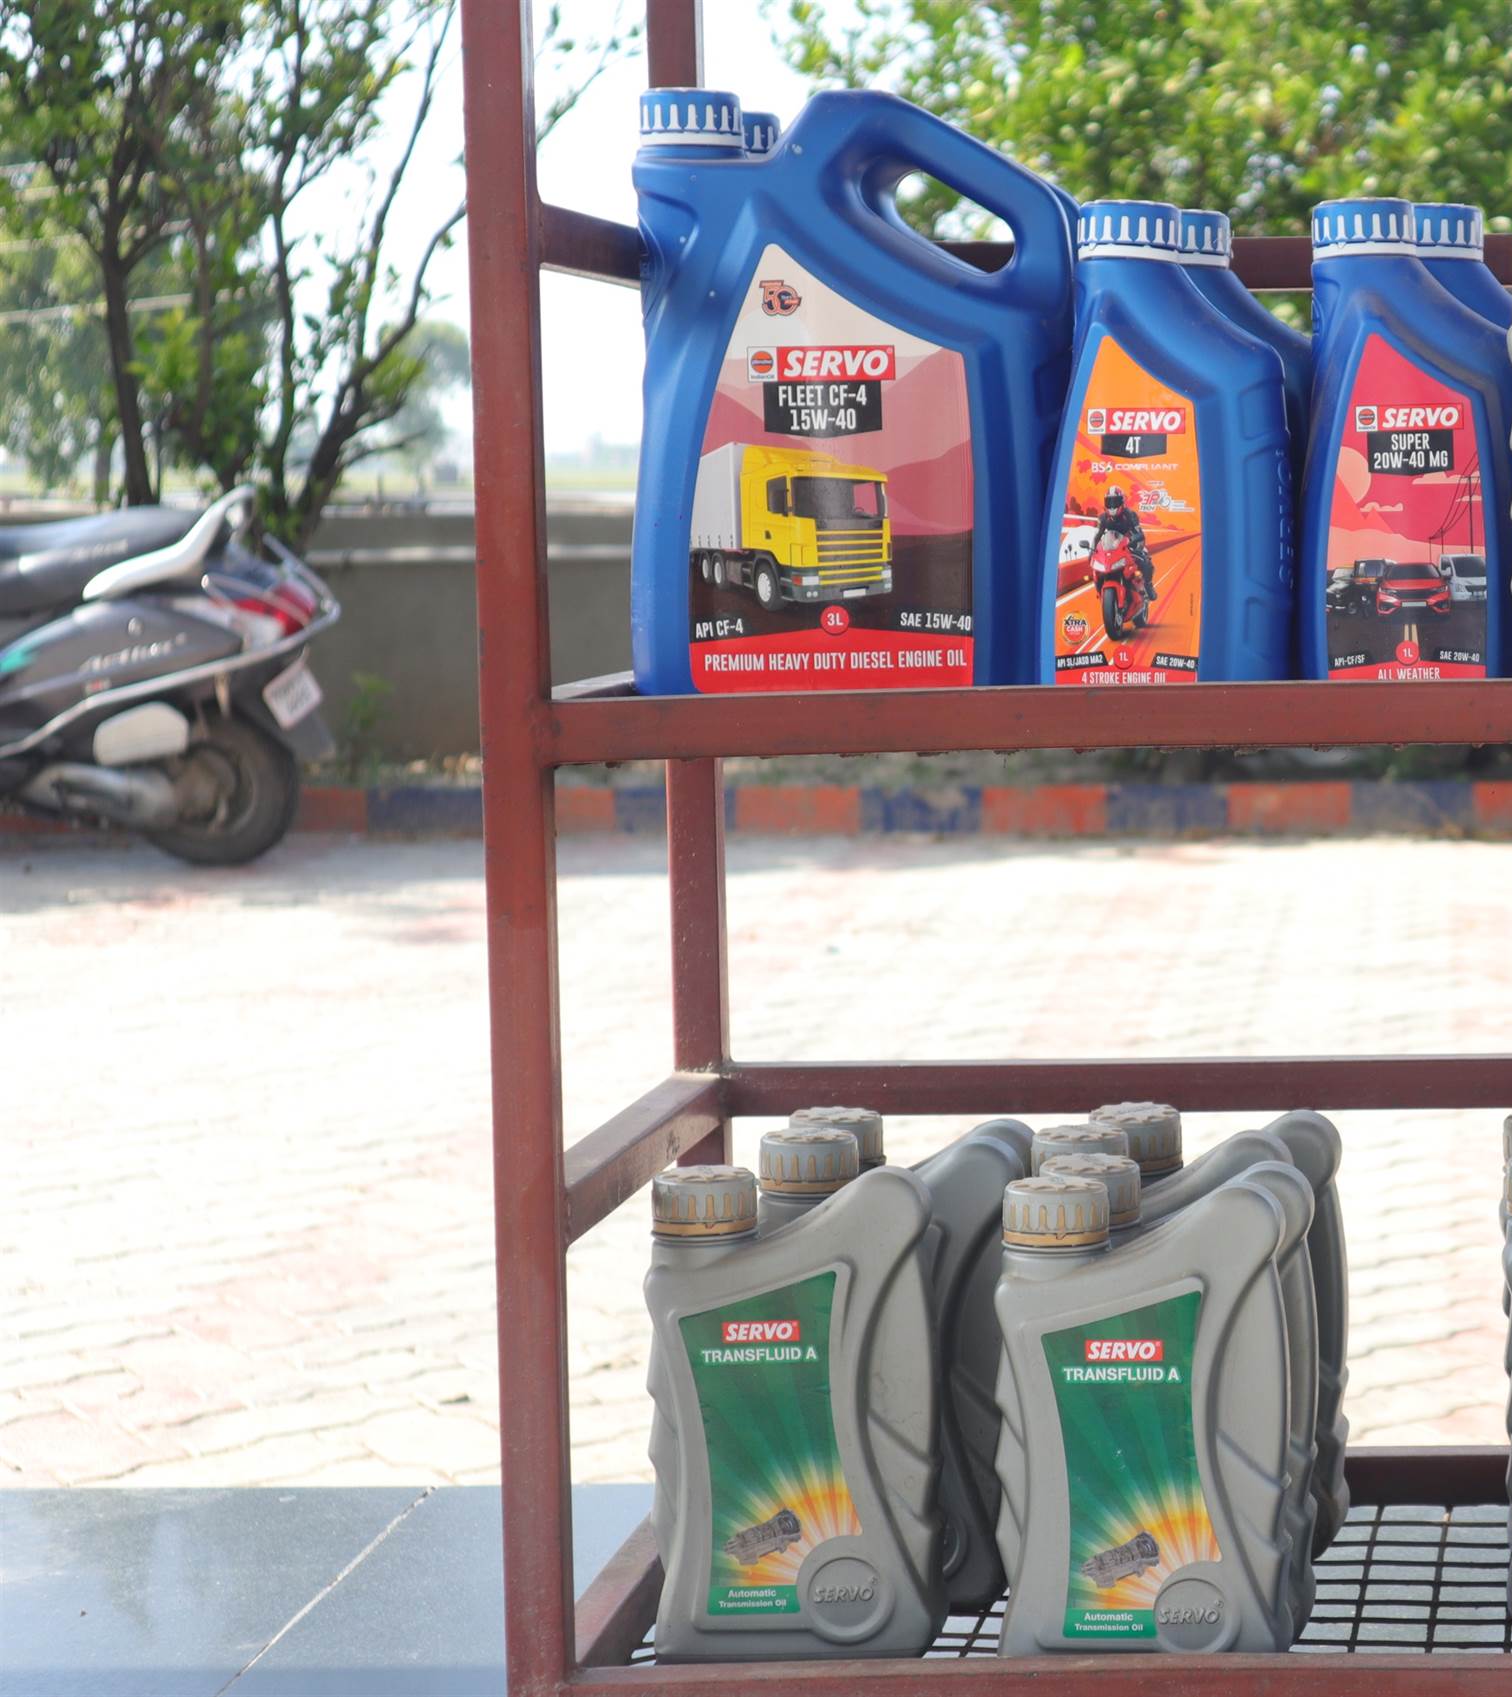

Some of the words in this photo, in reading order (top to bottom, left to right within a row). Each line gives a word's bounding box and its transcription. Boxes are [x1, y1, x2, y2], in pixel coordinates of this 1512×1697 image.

[784, 349, 888, 377] SERVO
[778, 384, 824, 406] FLEET
[829, 384, 867, 406] CF-4
[790, 408, 856, 430] 15W-40
[1110, 411, 1181, 431] SERVO
[1382, 407, 1459, 428] SERVO
[1125, 436, 1141, 454] 4T
[1391, 433, 1430, 450] SUPER
[1374, 451, 1425, 470] 20W-40
[1429, 451, 1448, 467] MG
[696, 622, 713, 638] API
[716, 618, 743, 636] CF-4
[827, 614, 844, 626] 3L
[900, 612, 921, 627] SAE
[925, 612, 972, 631] 15W-40
[704, 653, 764, 671] PREMIUM
[769, 653, 809, 671] HEAVY
[814, 652, 846, 670] DUTY
[850, 651, 894, 669] DIESEL
[898, 650, 943, 668] ENGINE
[947, 649, 967, 667] OIL
[1081, 672, 1088, 684] 4
[1089, 672, 1120, 684] STROKE
[1122, 672, 1152, 684] ENGINE
[1396, 667, 1440, 680] WEATHER
[726, 1322, 793, 1341] SERVO
[702, 1347, 801, 1363] TRANSFLUID
[806, 1346, 817, 1359] A
[1088, 1341, 1156, 1360] SERVO
[1063, 1367, 1164, 1381] TRANSFLUID
[1167, 1367, 1180, 1381] A
[728, 1589, 776, 1599] Automatic
[814, 1586, 874, 1604] SERVO
[719, 1600, 773, 1609] Transmission
[775, 1599, 787, 1608] Oil
[1083, 1612, 1133, 1621] Automatic
[1158, 1608, 1220, 1625] SERVO
